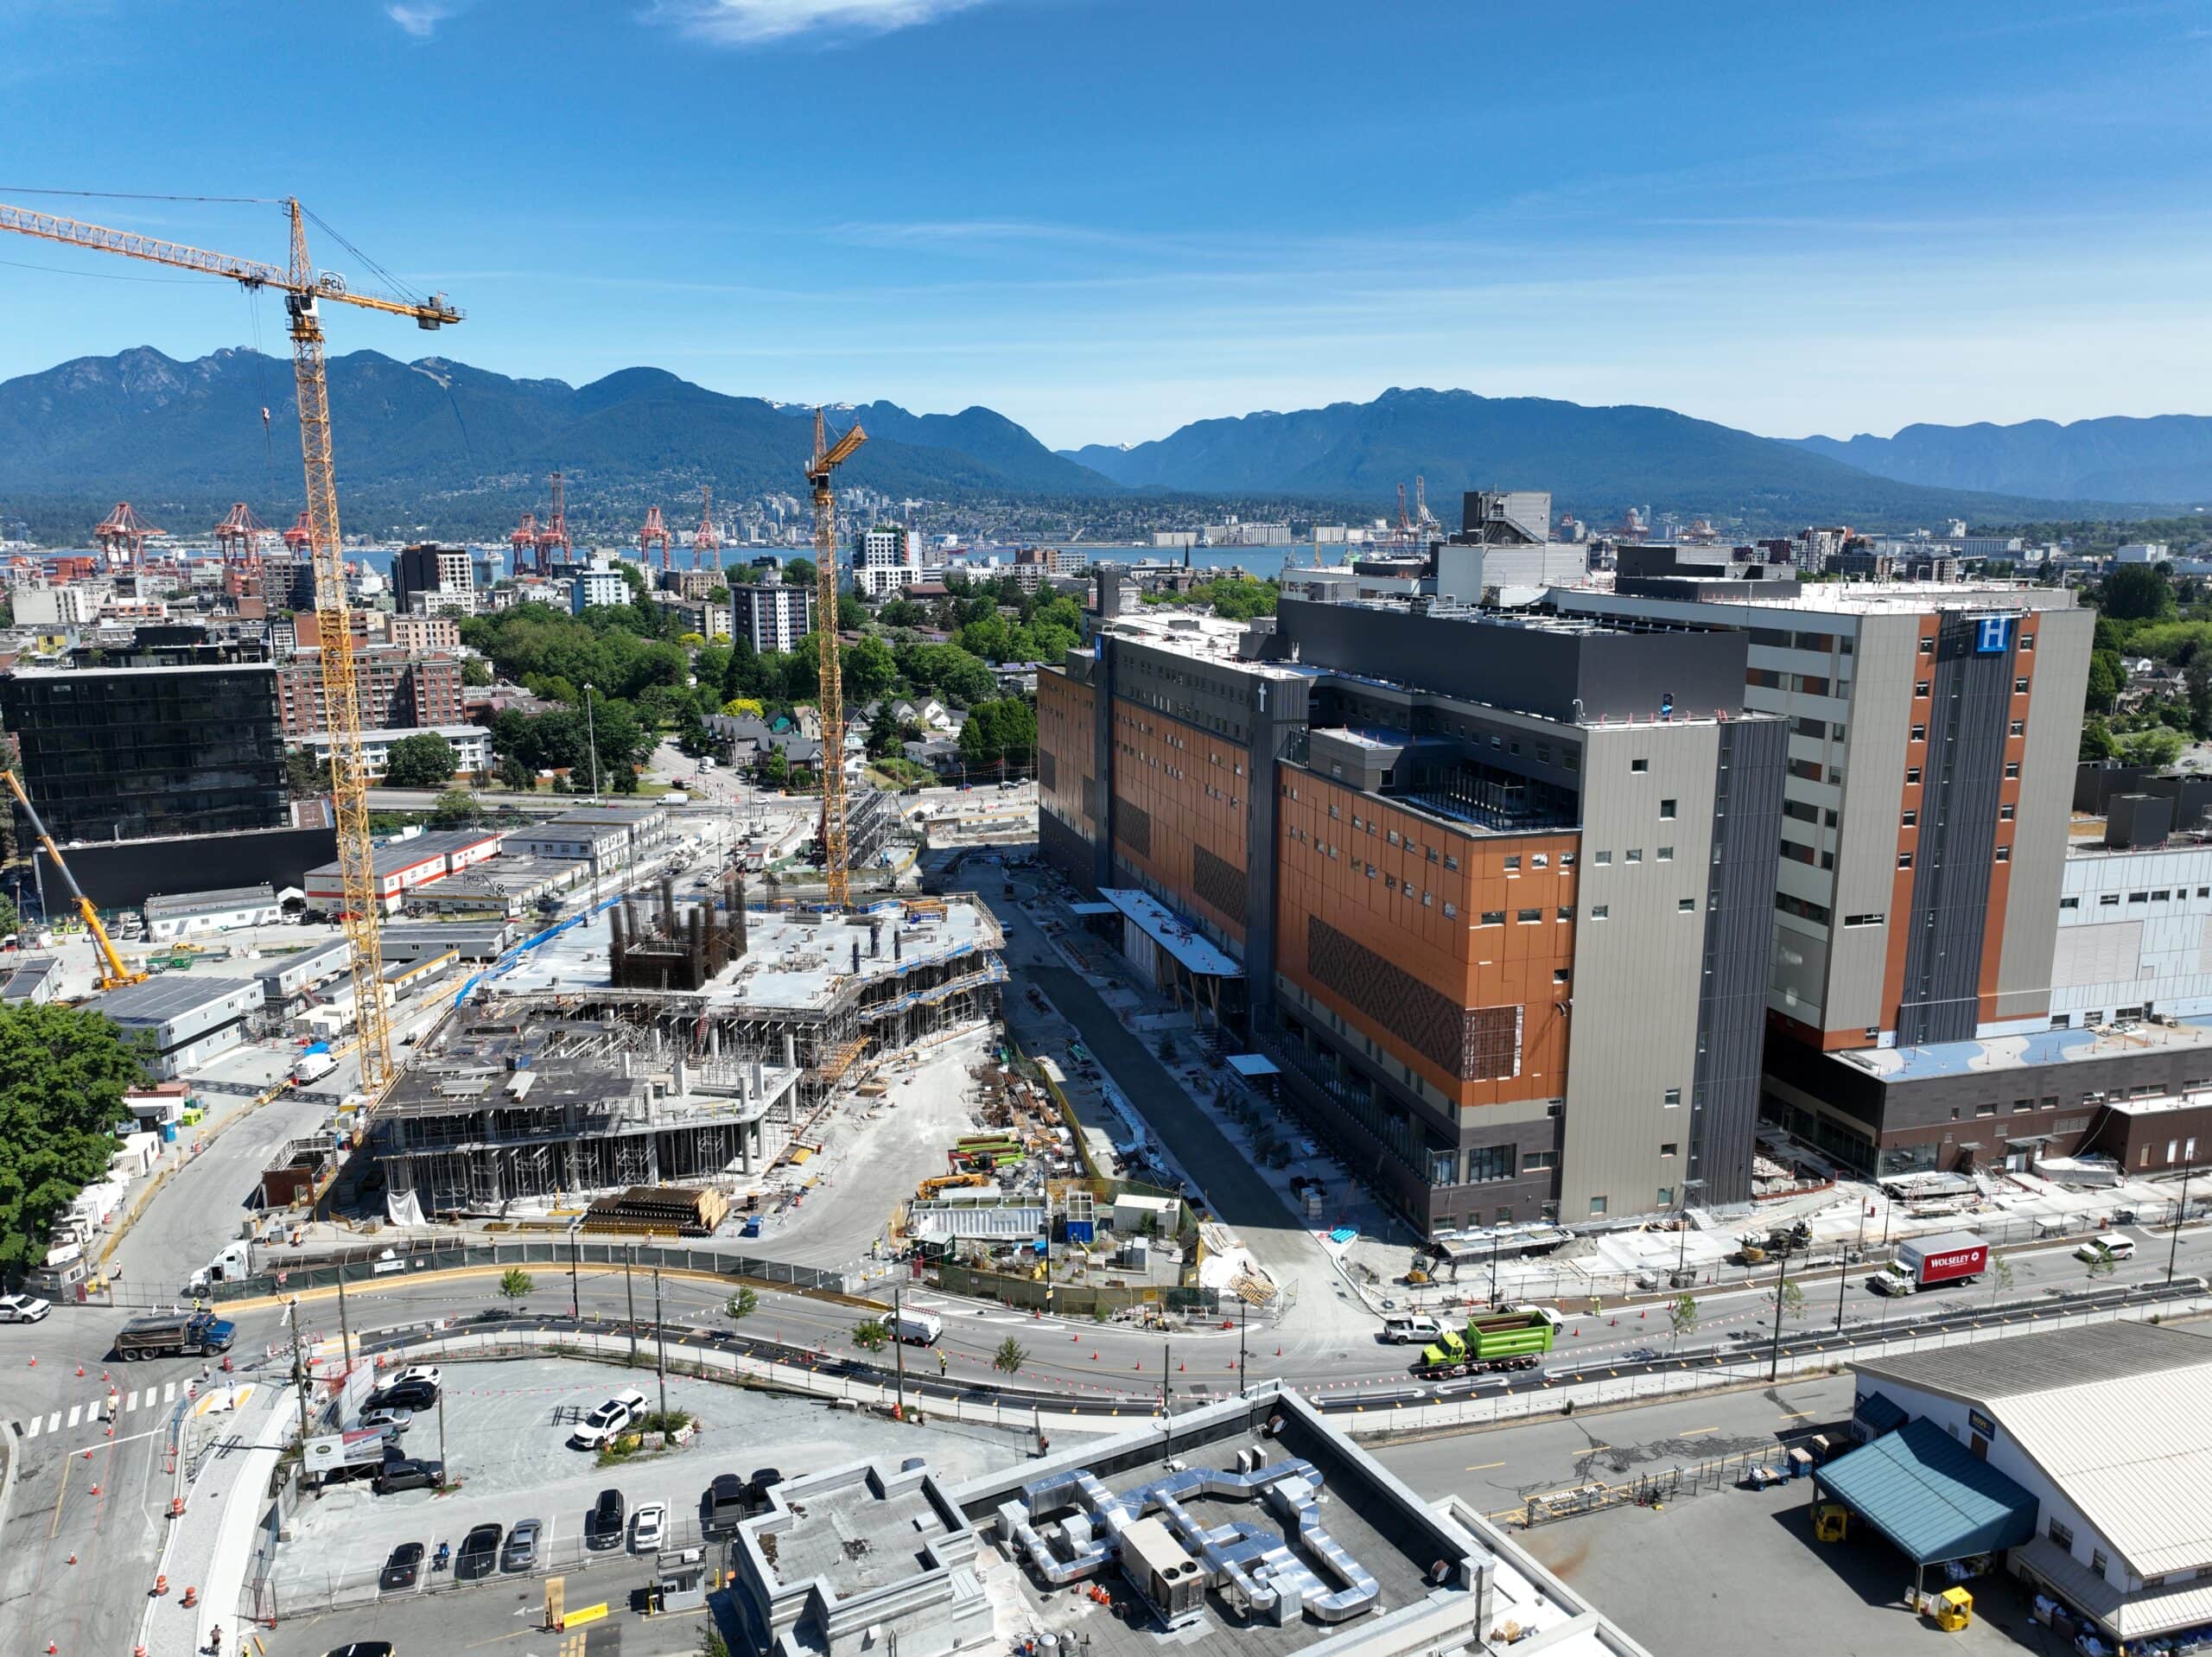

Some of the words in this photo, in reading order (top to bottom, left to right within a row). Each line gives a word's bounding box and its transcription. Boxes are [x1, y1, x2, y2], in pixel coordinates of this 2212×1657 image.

[325, 278, 342, 289] PCL
[1983, 619, 2005, 648] H
[1930, 1254, 1969, 1268] WOLSELEY
